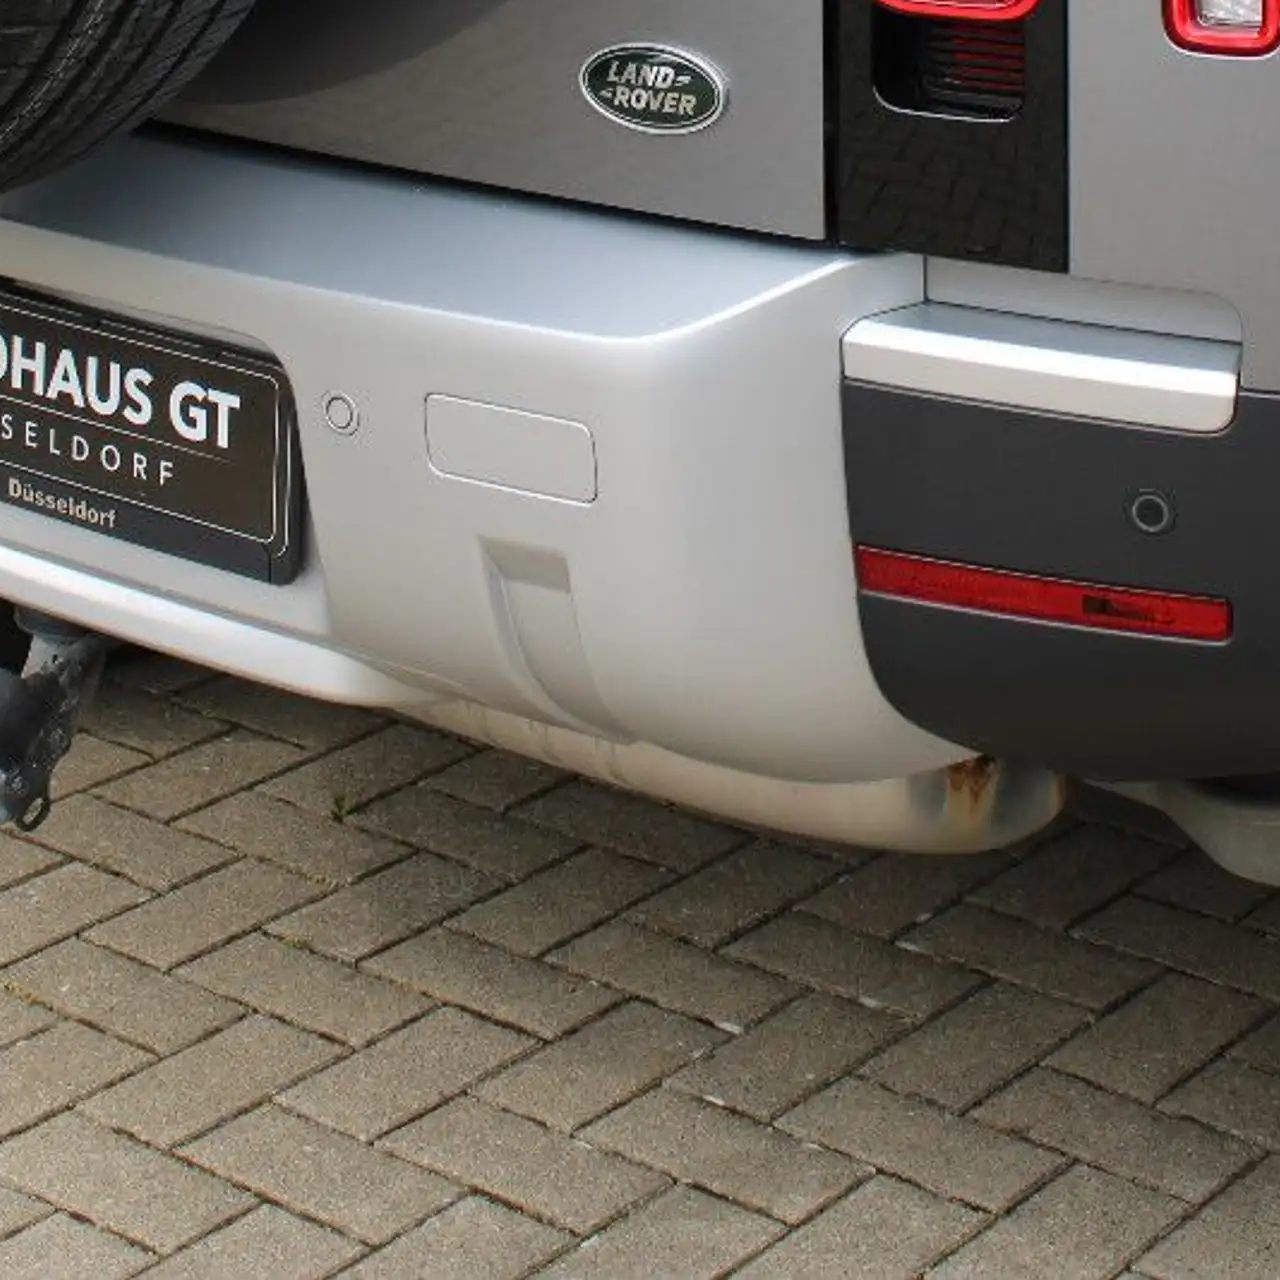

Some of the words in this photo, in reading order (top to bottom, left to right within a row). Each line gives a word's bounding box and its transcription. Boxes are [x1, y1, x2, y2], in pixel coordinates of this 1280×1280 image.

[607, 61, 676, 89] LAND
[614, 85, 697, 116] ROVER
[168, 382, 241, 450] GT
[7, 475, 117, 530] Düsseldorf
